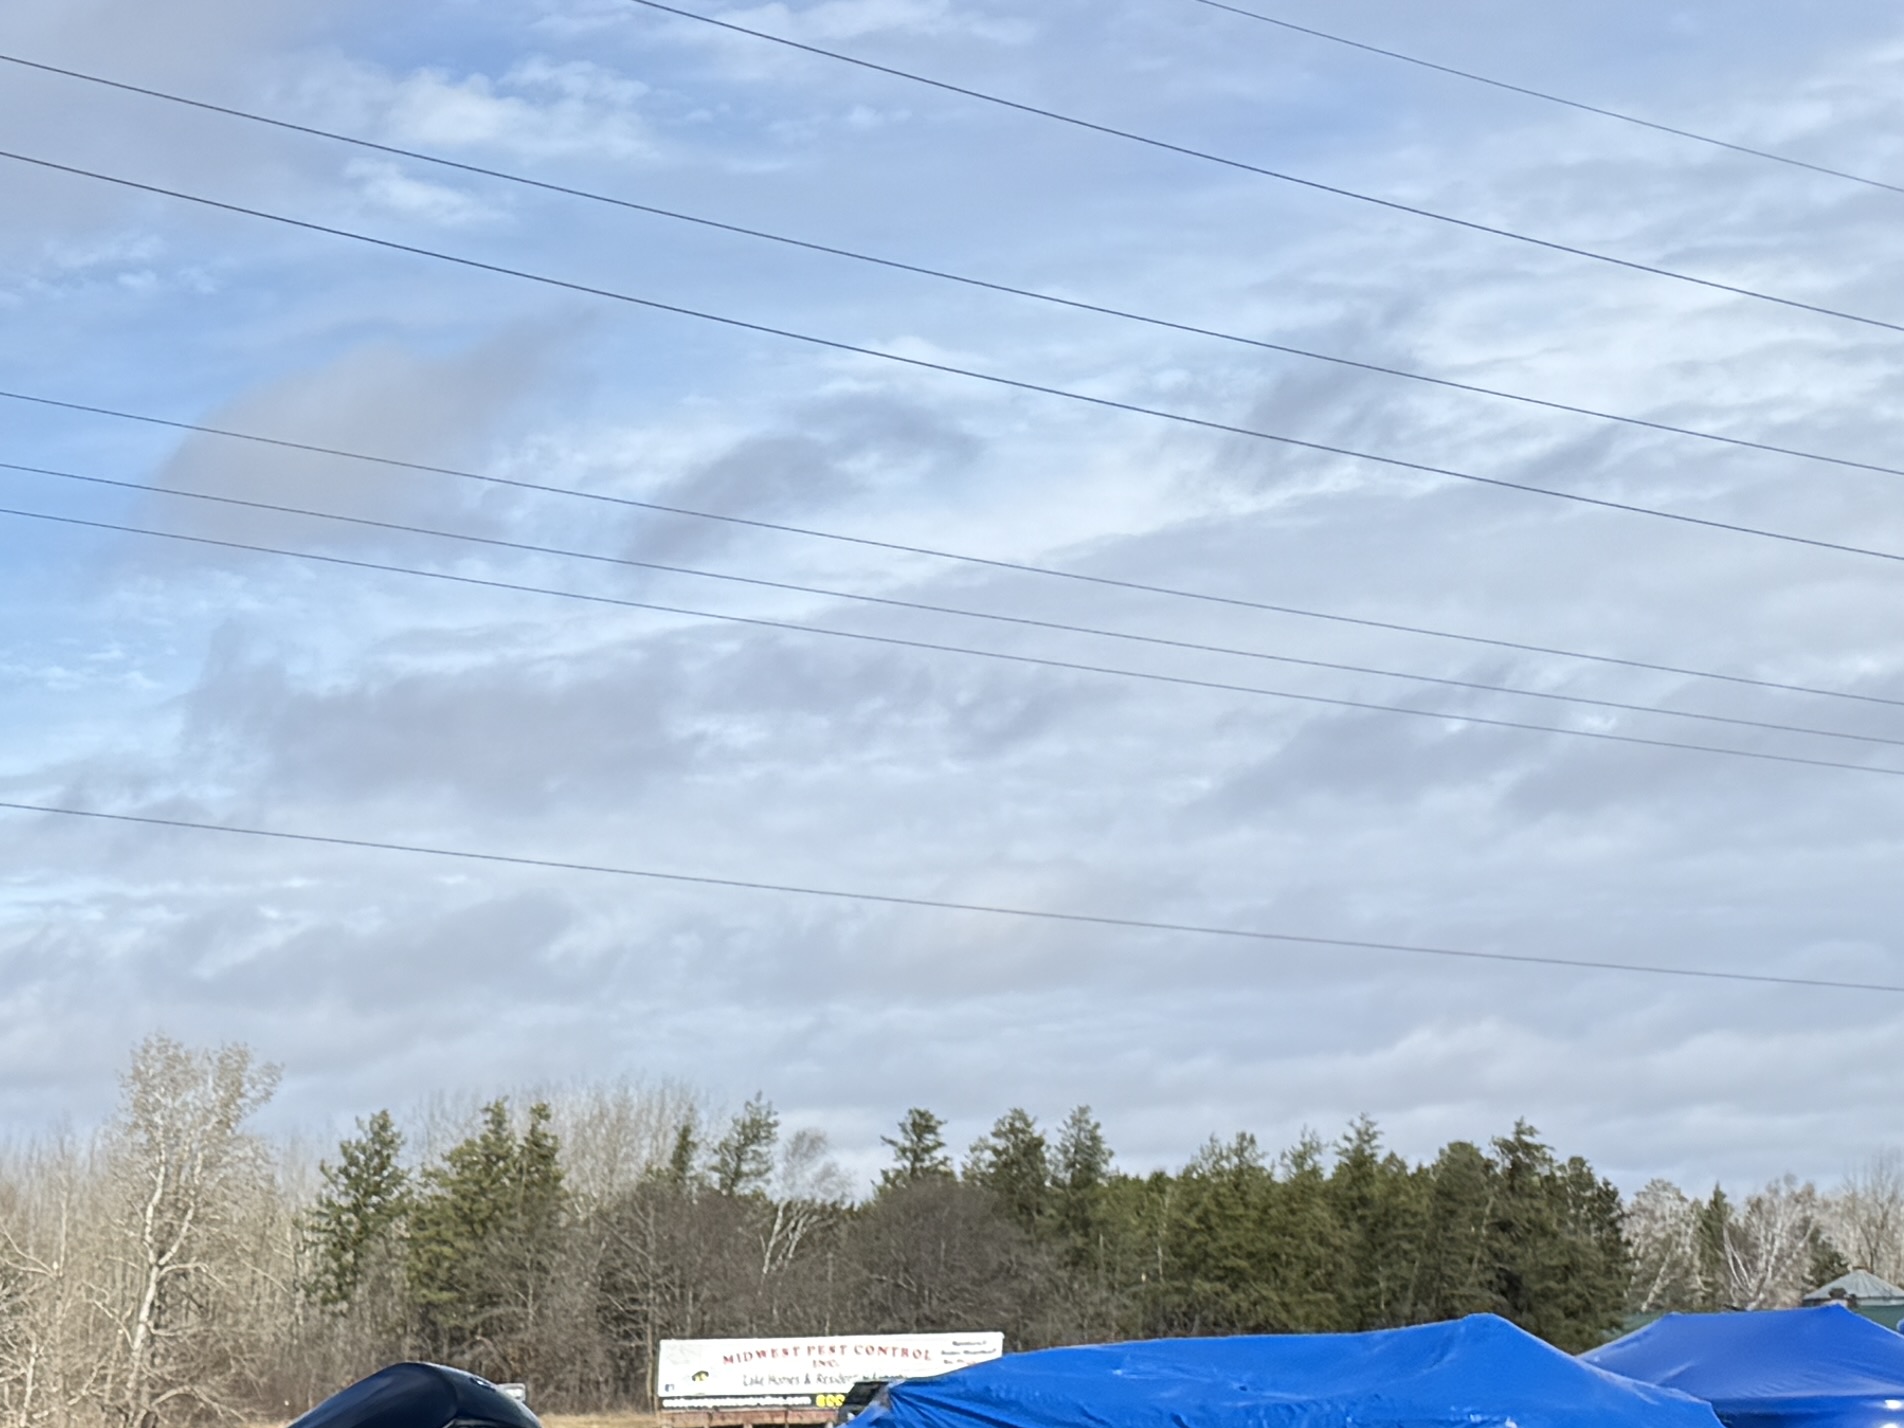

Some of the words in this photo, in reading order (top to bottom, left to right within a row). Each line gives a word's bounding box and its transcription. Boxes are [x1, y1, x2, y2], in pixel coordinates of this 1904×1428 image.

[723, 1347, 800, 1364] MIDWEST
[807, 1345, 847, 1356] PEST
[854, 1345, 932, 1361] CONTROL
